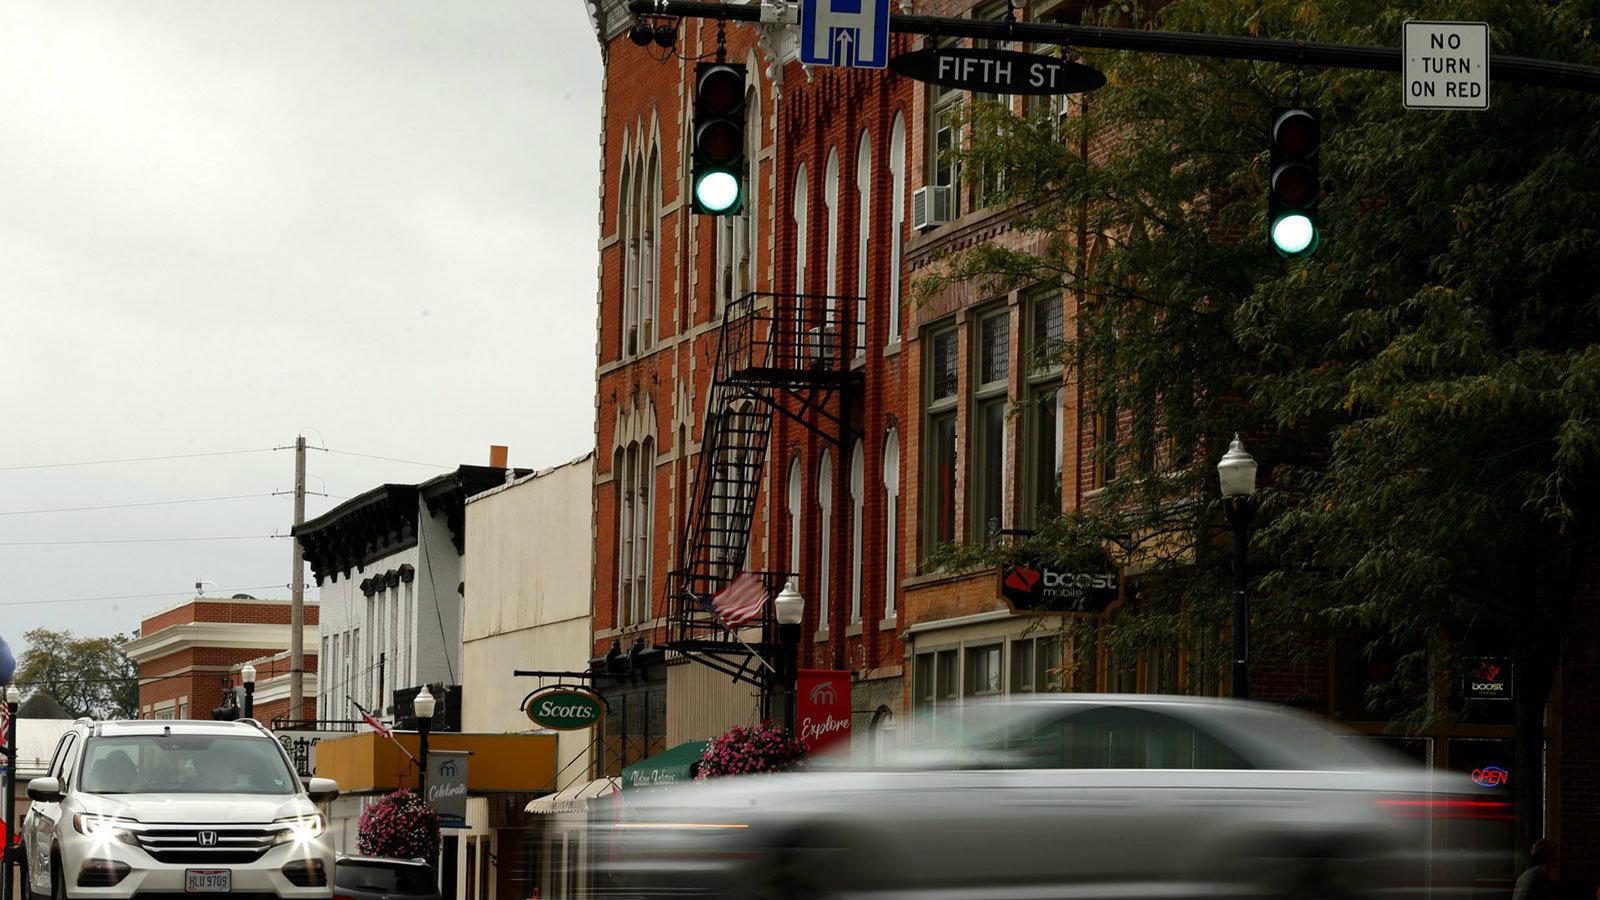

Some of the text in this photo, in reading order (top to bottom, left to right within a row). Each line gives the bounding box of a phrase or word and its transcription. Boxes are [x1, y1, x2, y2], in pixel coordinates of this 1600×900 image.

[814, 0, 876, 61] H
[1431, 33, 1461, 49] NO
[938, 55, 1061, 88] FIFTH ST
[1422, 57, 1470, 73] TURN
[1411, 81, 1481, 97] ON RED
[1043, 567, 1117, 589] boost
[1043, 588, 1083, 598] mobile
[538, 701, 593, 718] Scotts
[801, 715, 850, 740] Explore
[1471, 768, 1508, 785] OPEN
[429, 782, 467, 802] Celebrate
